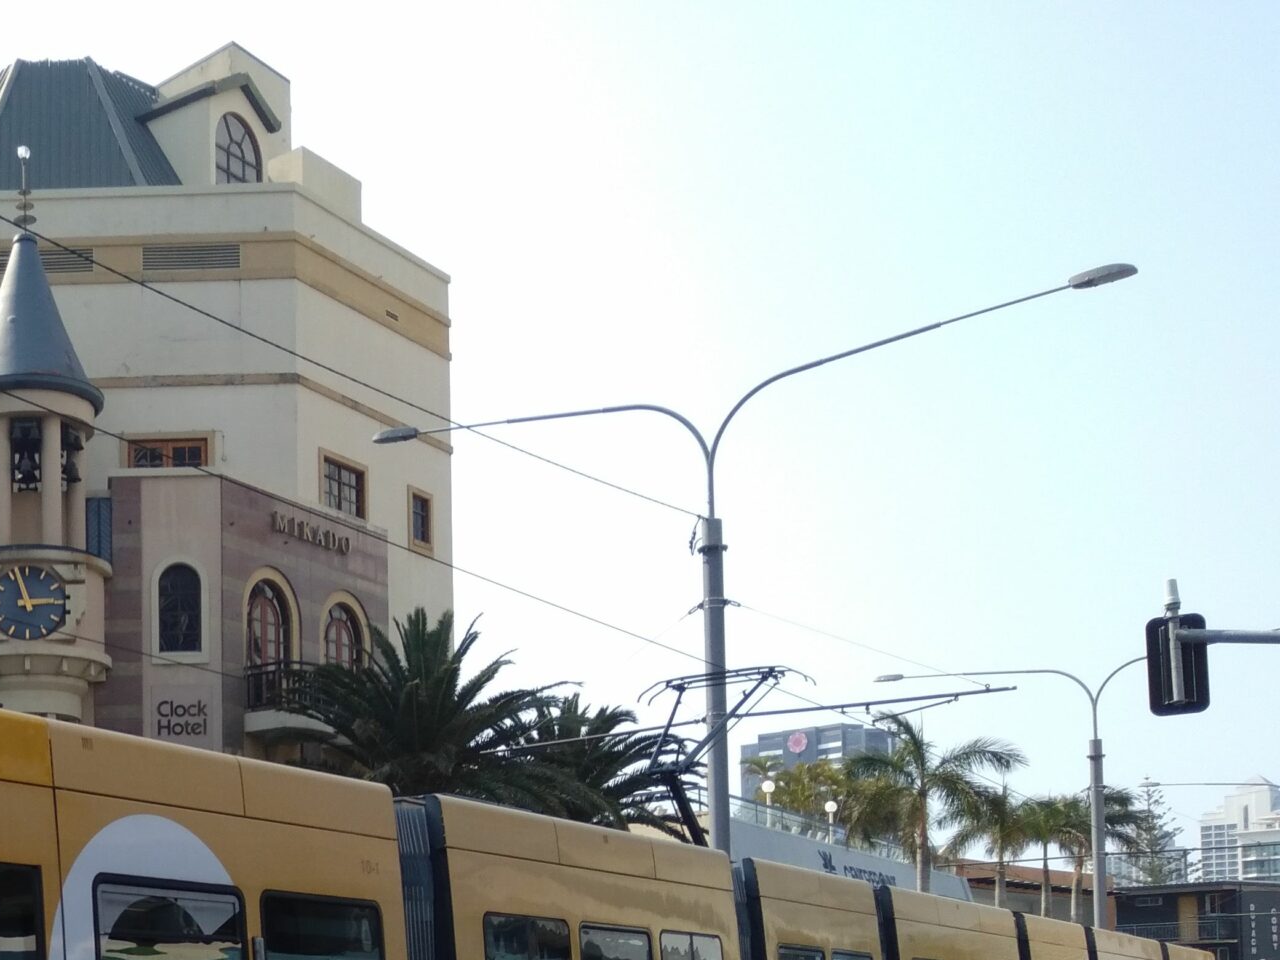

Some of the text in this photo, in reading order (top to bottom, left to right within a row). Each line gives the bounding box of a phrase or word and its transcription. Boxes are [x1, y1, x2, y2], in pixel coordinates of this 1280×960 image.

[275, 512, 352, 553] MIKADO
[157, 699, 208, 718] Clock
[157, 718, 207, 736] Hotel
